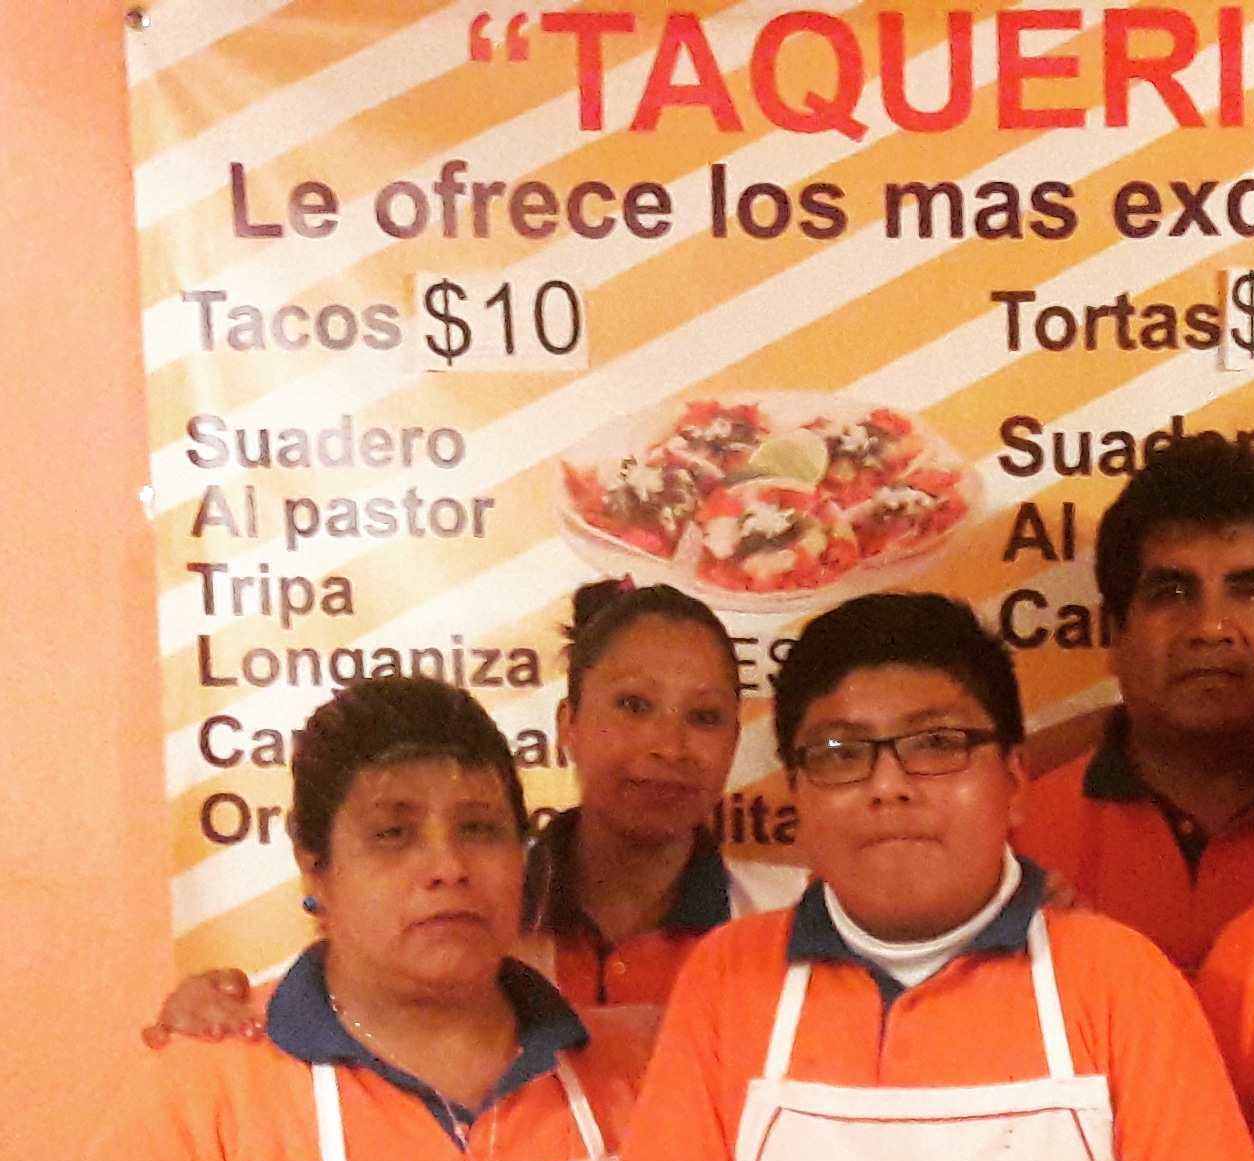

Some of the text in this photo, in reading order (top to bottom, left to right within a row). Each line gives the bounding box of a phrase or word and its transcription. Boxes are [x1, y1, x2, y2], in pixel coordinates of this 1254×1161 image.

[230, 161, 340, 240] Le
[374, 159, 672, 240] ofrece
[710, 162, 848, 240] los
[885, 178, 1078, 240] mas
[180, 289, 403, 352] Tacos
[424, 277, 582, 366] $10
[991, 290, 1221, 352] Tortas
[185, 415, 467, 470] Suadero
[192, 485, 494, 552] Al pastor
[1002, 501, 1076, 562] Al
[188, 562, 353, 630] Tripa
[197, 634, 543, 700] Longaniza
